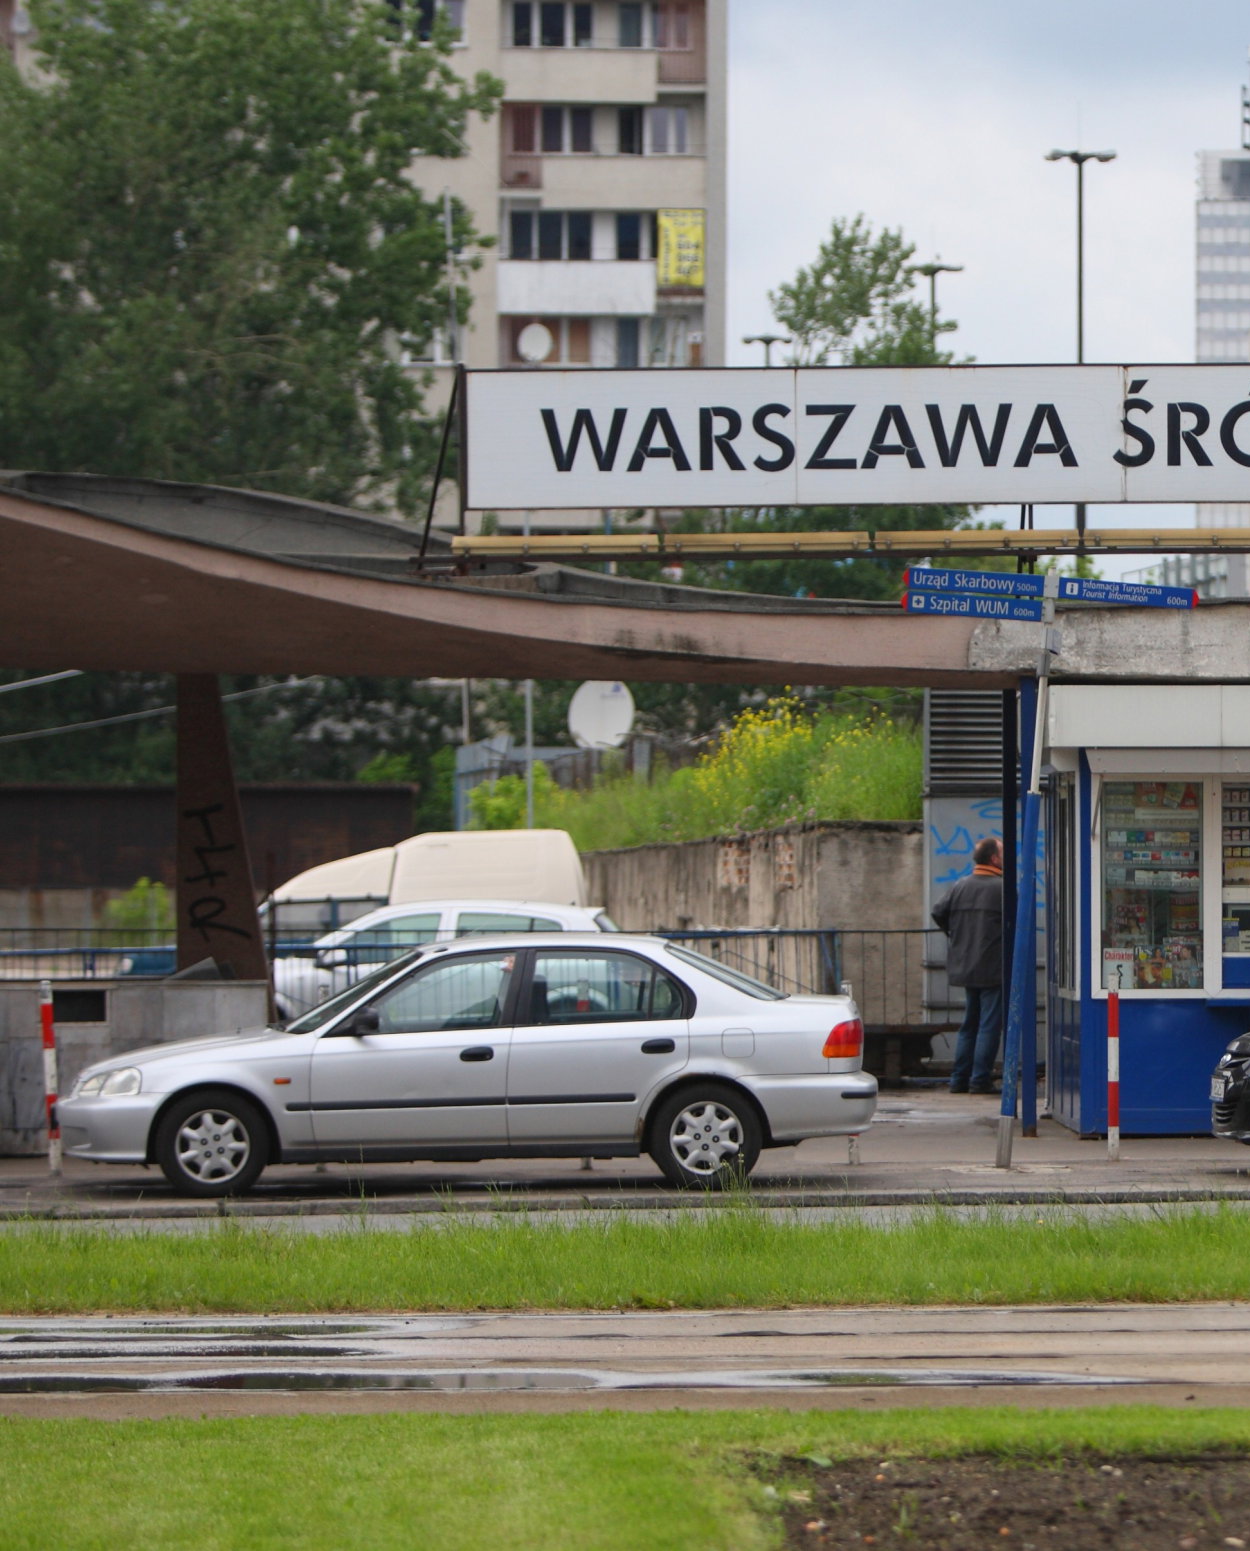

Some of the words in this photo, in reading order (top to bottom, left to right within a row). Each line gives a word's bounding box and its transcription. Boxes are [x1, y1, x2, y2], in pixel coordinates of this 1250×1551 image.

[541, 402, 1078, 472] WARSZAWA
[913, 571, 949, 589] Urząd
[954, 573, 1015, 594] Skarbowy
[1016, 583, 1037, 592] 500m
[1082, 581, 1119, 592] Informacja
[1122, 584, 1162, 595] Turystyczna
[930, 595, 970, 613] Szpital
[976, 599, 1009, 615] WUM
[1013, 608, 1035, 617] 600m
[1082, 589, 1105, 599] Tourist
[1108, 592, 1148, 602] Information
[1167, 596, 1188, 606] 600m
